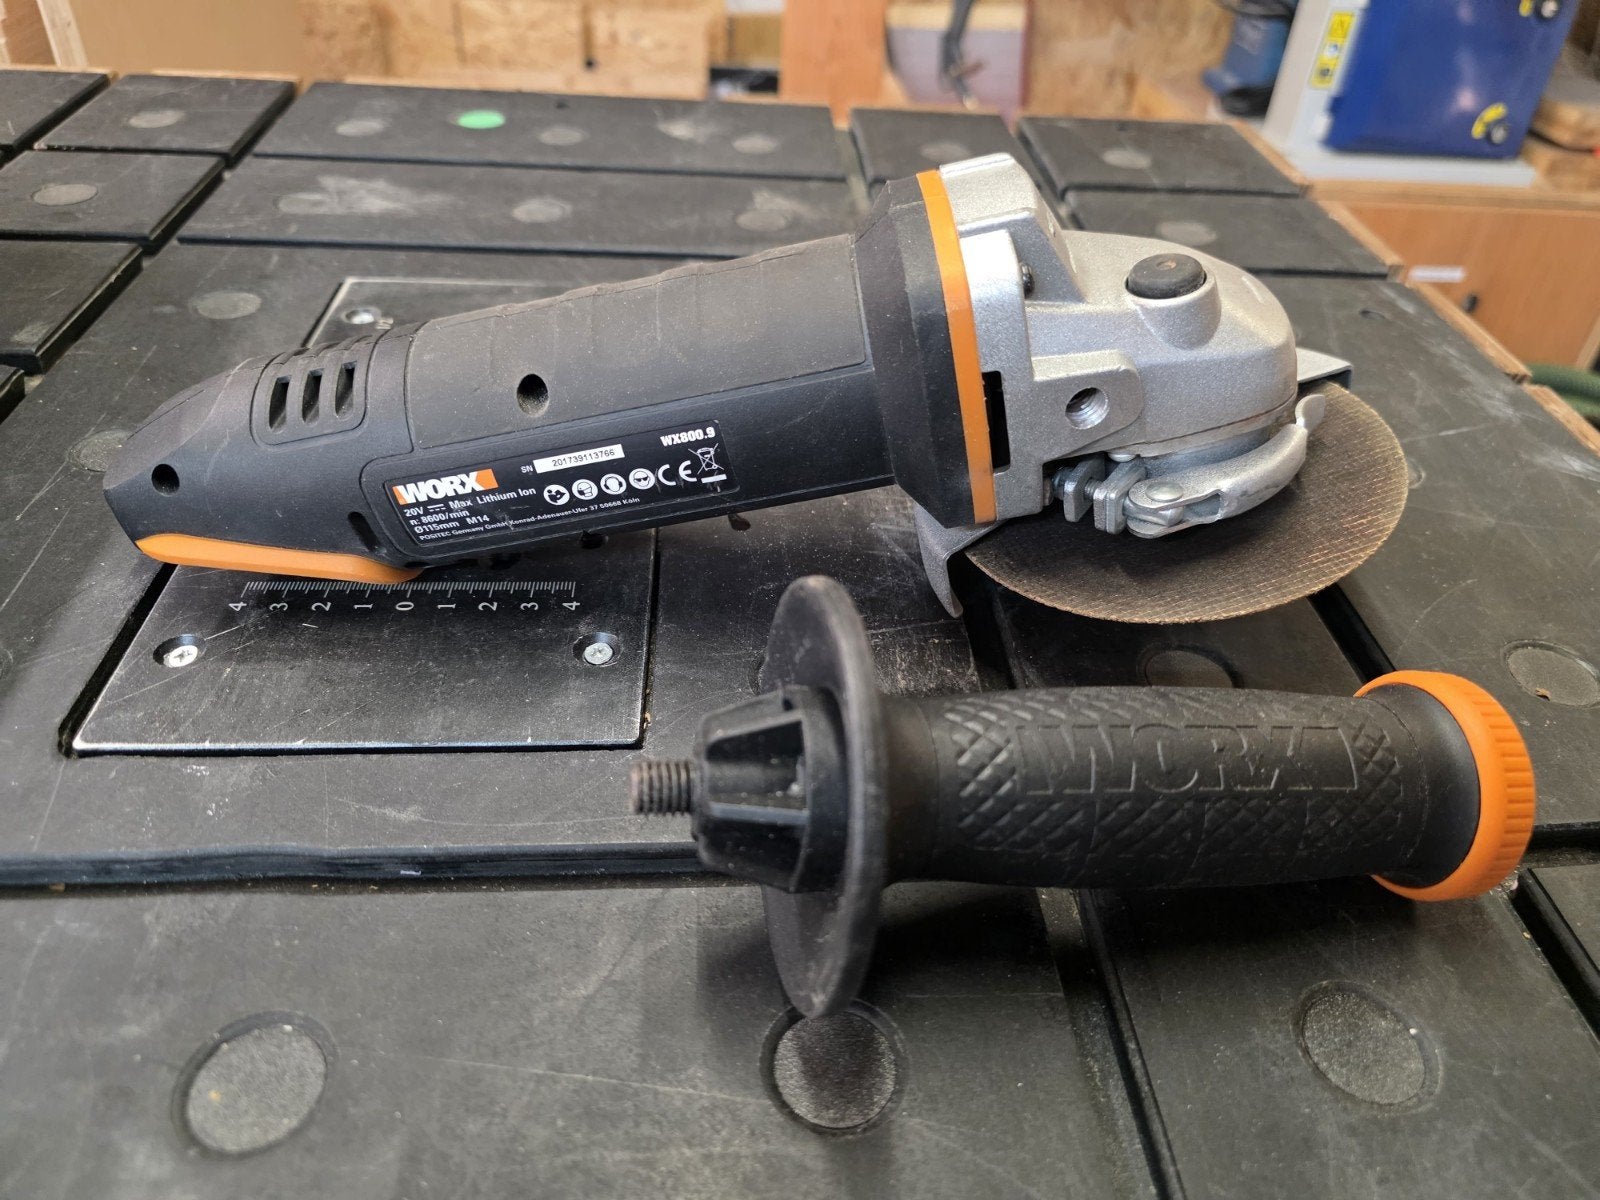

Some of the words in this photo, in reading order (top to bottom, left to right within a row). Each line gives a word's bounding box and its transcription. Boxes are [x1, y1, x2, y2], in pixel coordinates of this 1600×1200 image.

[660, 426, 716, 447] WX800.9
[520, 464, 533, 474] SN
[551, 448, 615, 468] 201739113766
[399, 471, 486, 504] WORX
[404, 507, 424, 518] 20V
[449, 499, 473, 511] Max
[476, 489, 517, 505] Lithium
[518, 487, 537, 498] Ion
[420, 509, 470, 524] 8600/min
[466, 514, 490, 525] M14
[419, 530, 452, 541] POSITEC
[451, 526, 484, 536] Germany
[485, 521, 508, 530] GmbH
[228, 601, 247, 612] 4
[269, 602, 289, 611] 3
[311, 601, 332, 611] 2
[395, 601, 415, 611] 0
[478, 601, 498, 611] 2
[520, 602, 539, 611] 3
[562, 601, 581, 611] 4
